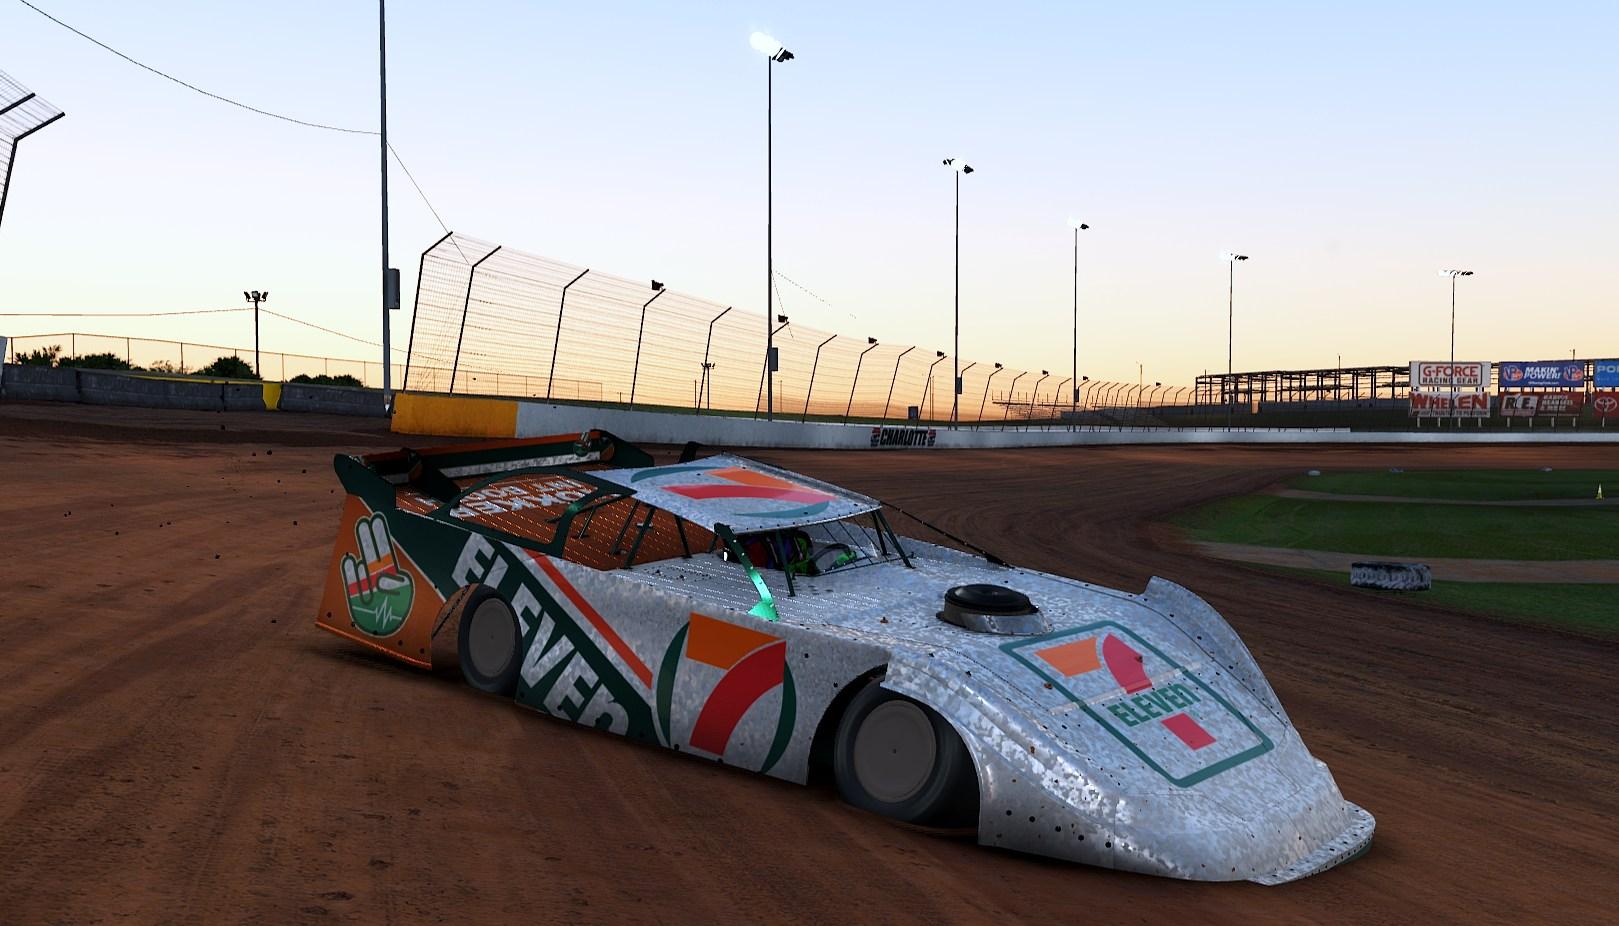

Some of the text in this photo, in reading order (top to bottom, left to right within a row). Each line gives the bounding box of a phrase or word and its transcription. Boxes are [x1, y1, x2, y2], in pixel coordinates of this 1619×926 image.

[1423, 366, 1478, 377] G-FORCE
[1597, 365, 1619, 374] PO
[880, 428, 929, 447] CHARLOTTE
